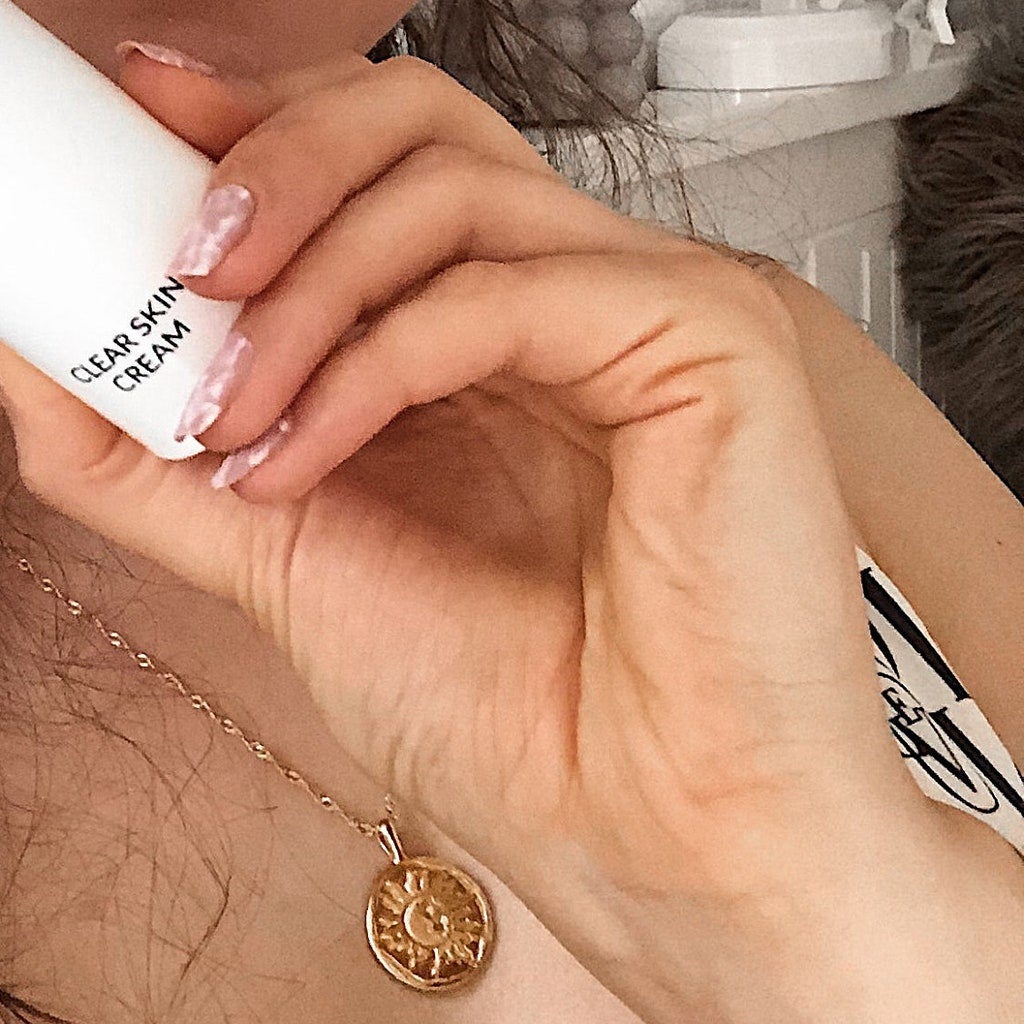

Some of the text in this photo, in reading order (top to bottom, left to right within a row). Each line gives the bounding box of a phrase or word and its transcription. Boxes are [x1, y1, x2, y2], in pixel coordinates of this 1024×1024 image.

[70, 276, 185, 383] CLEAR SKIN
[112, 319, 191, 392] CREAM
